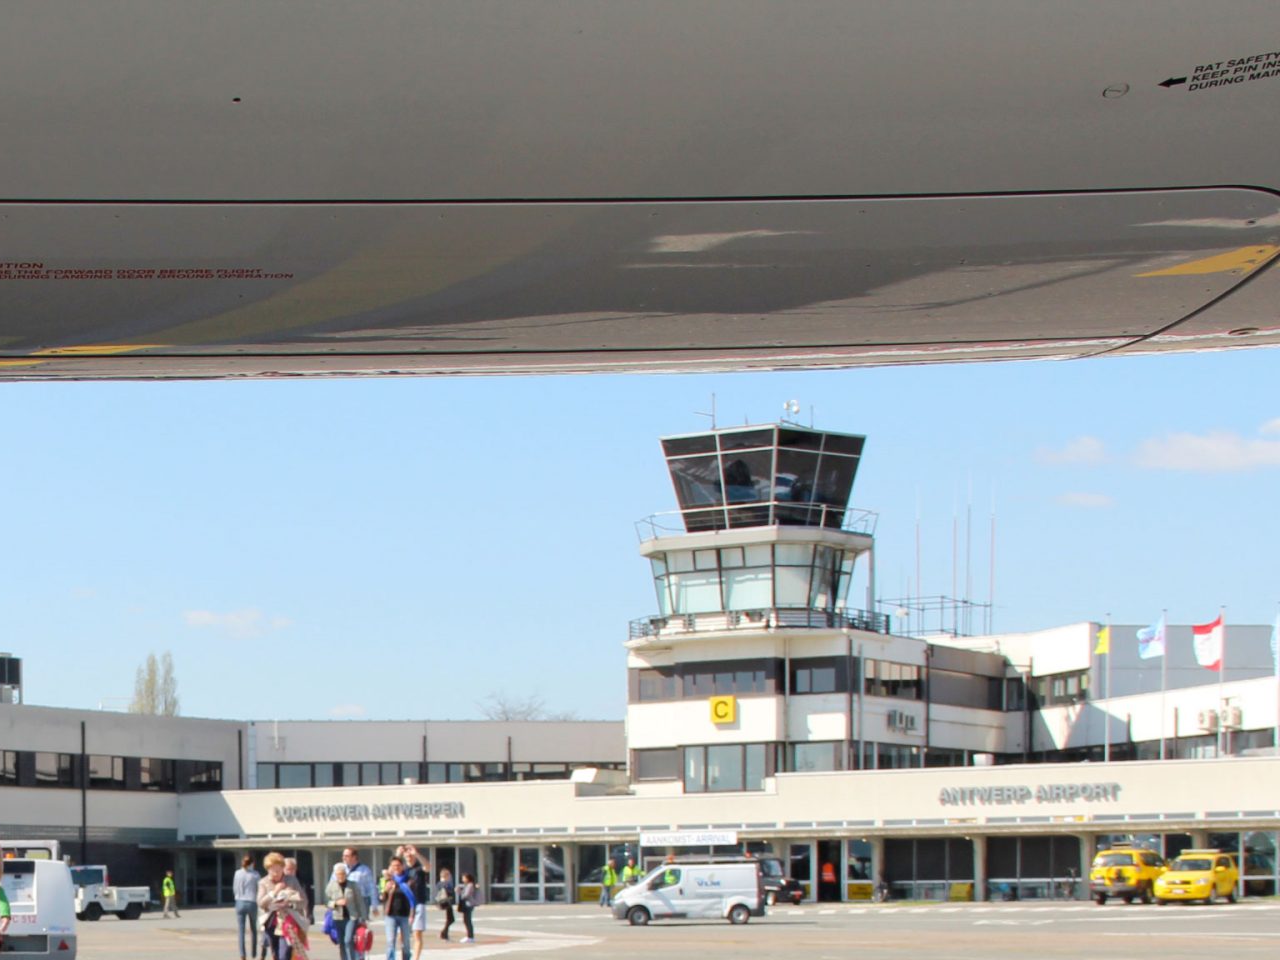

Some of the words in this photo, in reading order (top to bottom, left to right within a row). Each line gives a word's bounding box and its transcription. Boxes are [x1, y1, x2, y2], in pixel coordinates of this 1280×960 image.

[1194, 62, 1223, 73] RAT
[1227, 52, 1280, 67] SAFETY
[1191, 69, 1230, 82] KEEP
[1233, 64, 1258, 74] PIN
[1189, 76, 1245, 91] DURING
[714, 700, 728, 719] C
[938, 786, 1032, 806] ANTWERP
[1034, 783, 1121, 804] AIRPORT
[274, 804, 370, 822] LUCHTHAVEN
[371, 801, 465, 820] ANTWERPEN
